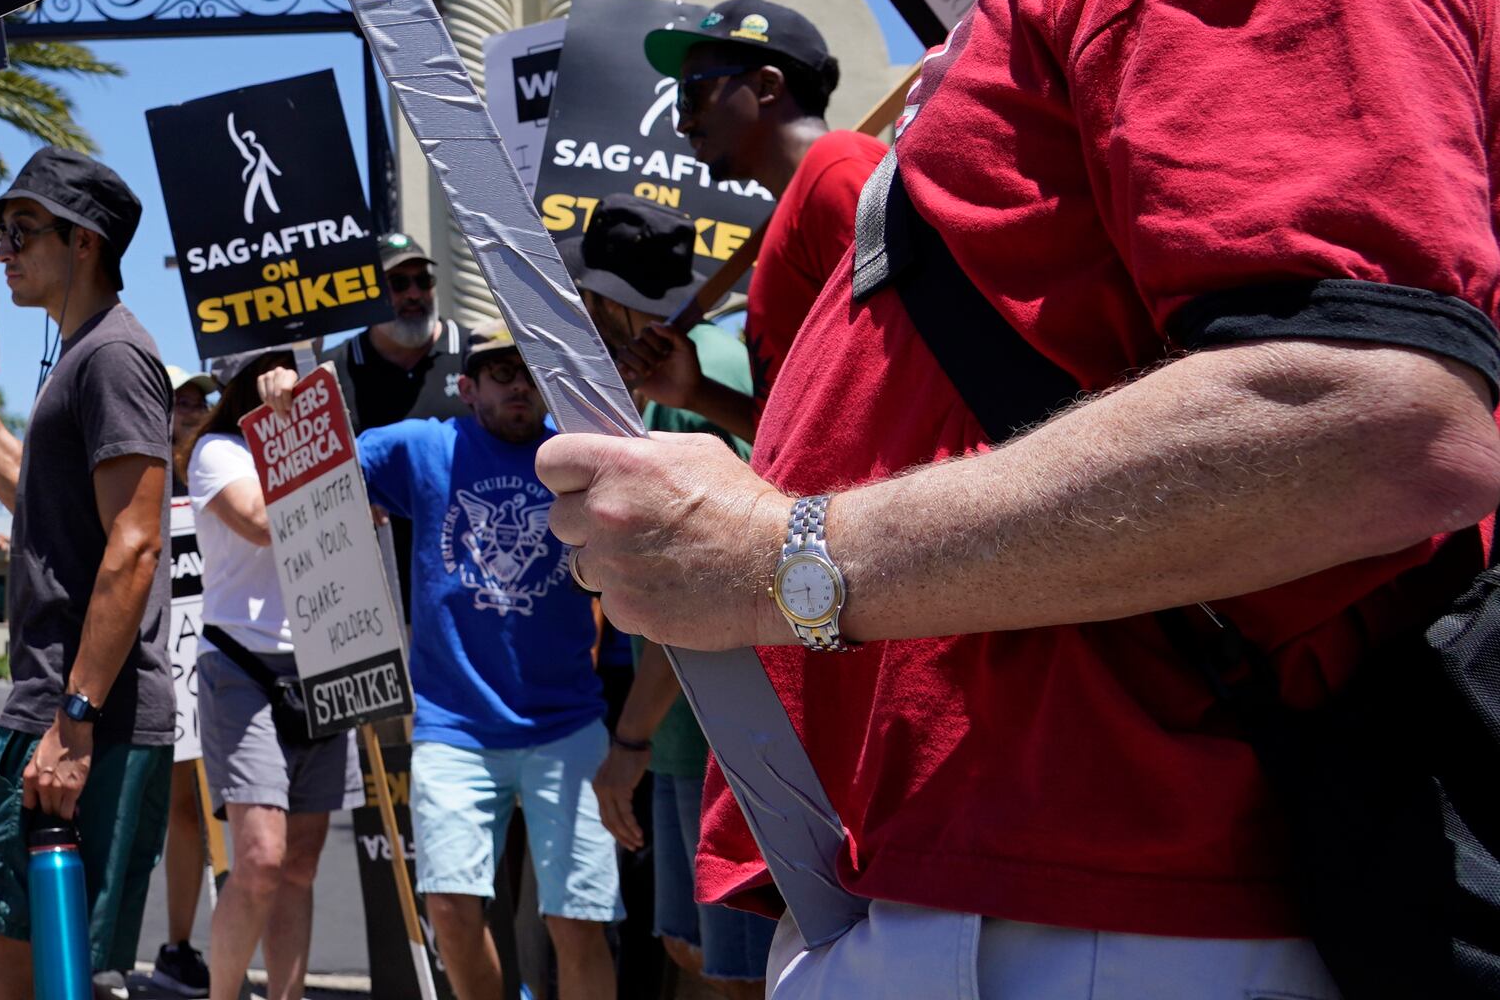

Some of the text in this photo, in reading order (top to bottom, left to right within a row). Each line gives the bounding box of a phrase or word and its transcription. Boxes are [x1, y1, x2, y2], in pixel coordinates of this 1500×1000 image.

[634, 182, 681, 208] ON
[197, 264, 381, 333] STRIKE!
[262, 259, 299, 282] ON
[263, 411, 331, 465] GUILD OF
[267, 430, 343, 492] AMERICA
[311, 473, 354, 521] HOTTER
[441, 504, 461, 573] WRITERS
[473, 476, 523, 493] GUILD
[525, 483, 548, 498] OF
[283, 521, 353, 584] THAN YOUR
[328, 607, 384, 654] HOLDERS
[312, 662, 404, 725] STRIKE
